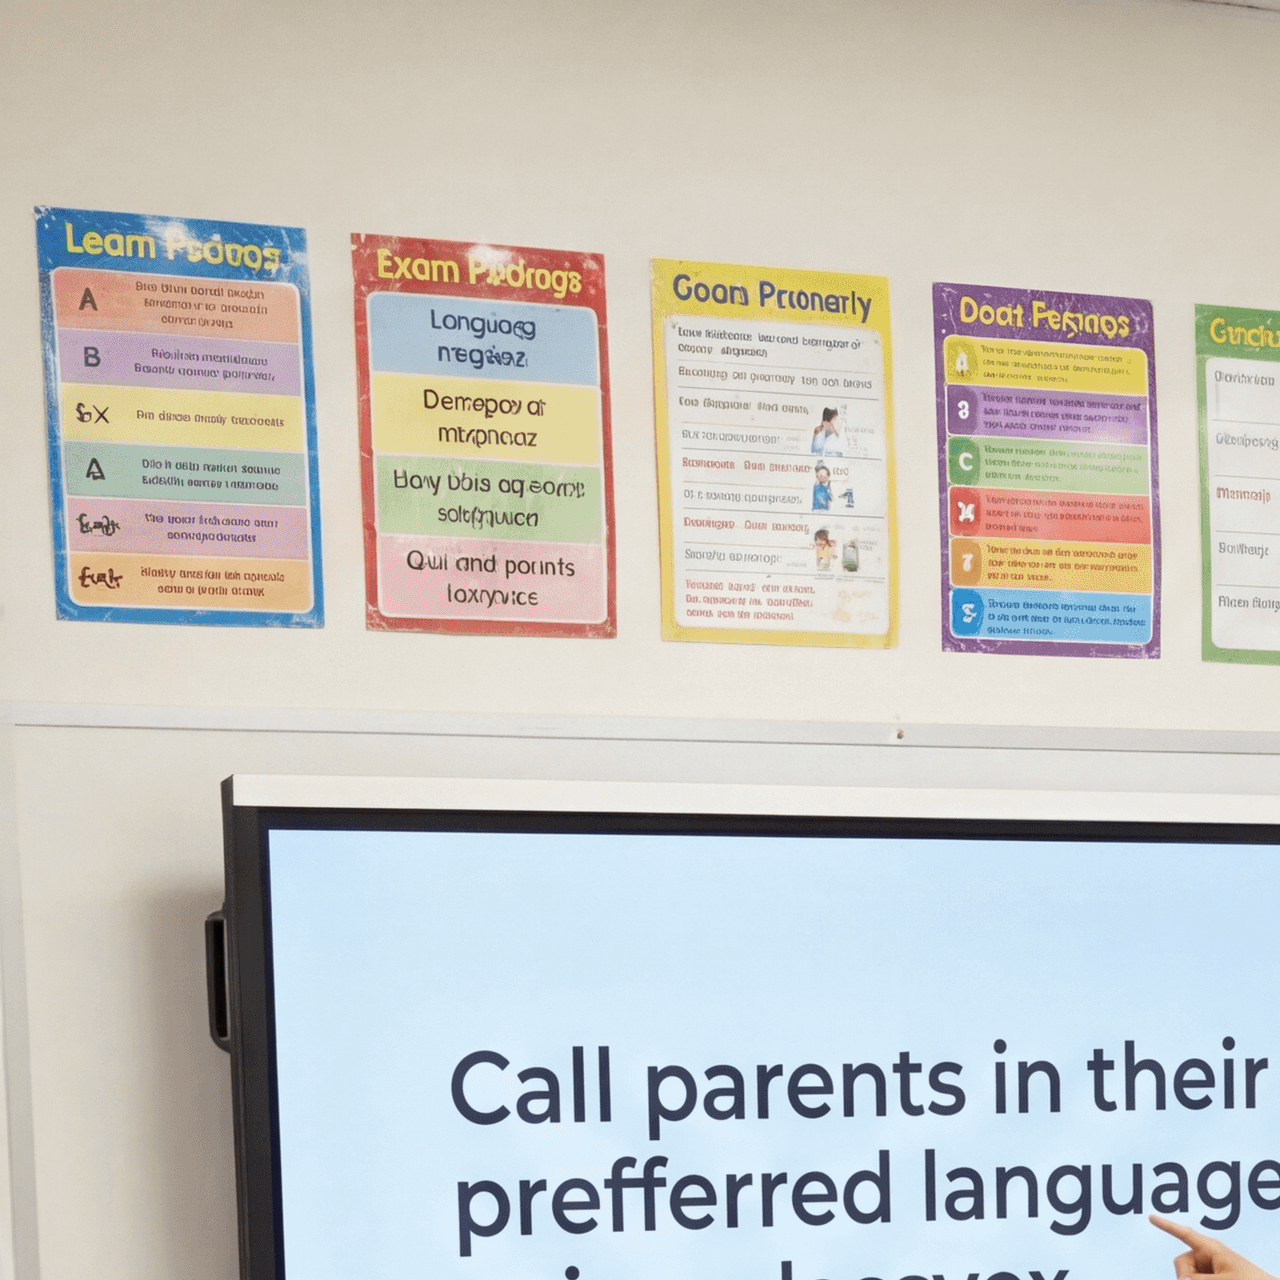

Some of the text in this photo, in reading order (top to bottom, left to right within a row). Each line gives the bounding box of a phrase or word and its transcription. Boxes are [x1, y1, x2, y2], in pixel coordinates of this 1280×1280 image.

[377, 248, 460, 284] Exam
[79, 286, 98, 312] A
[83, 346, 101, 368] B
[958, 451, 974, 471] C
[456, 555, 497, 573] and
[450, 1035, 1270, 1142] Call parents in their
[456, 1150, 892, 1259] prefferred
